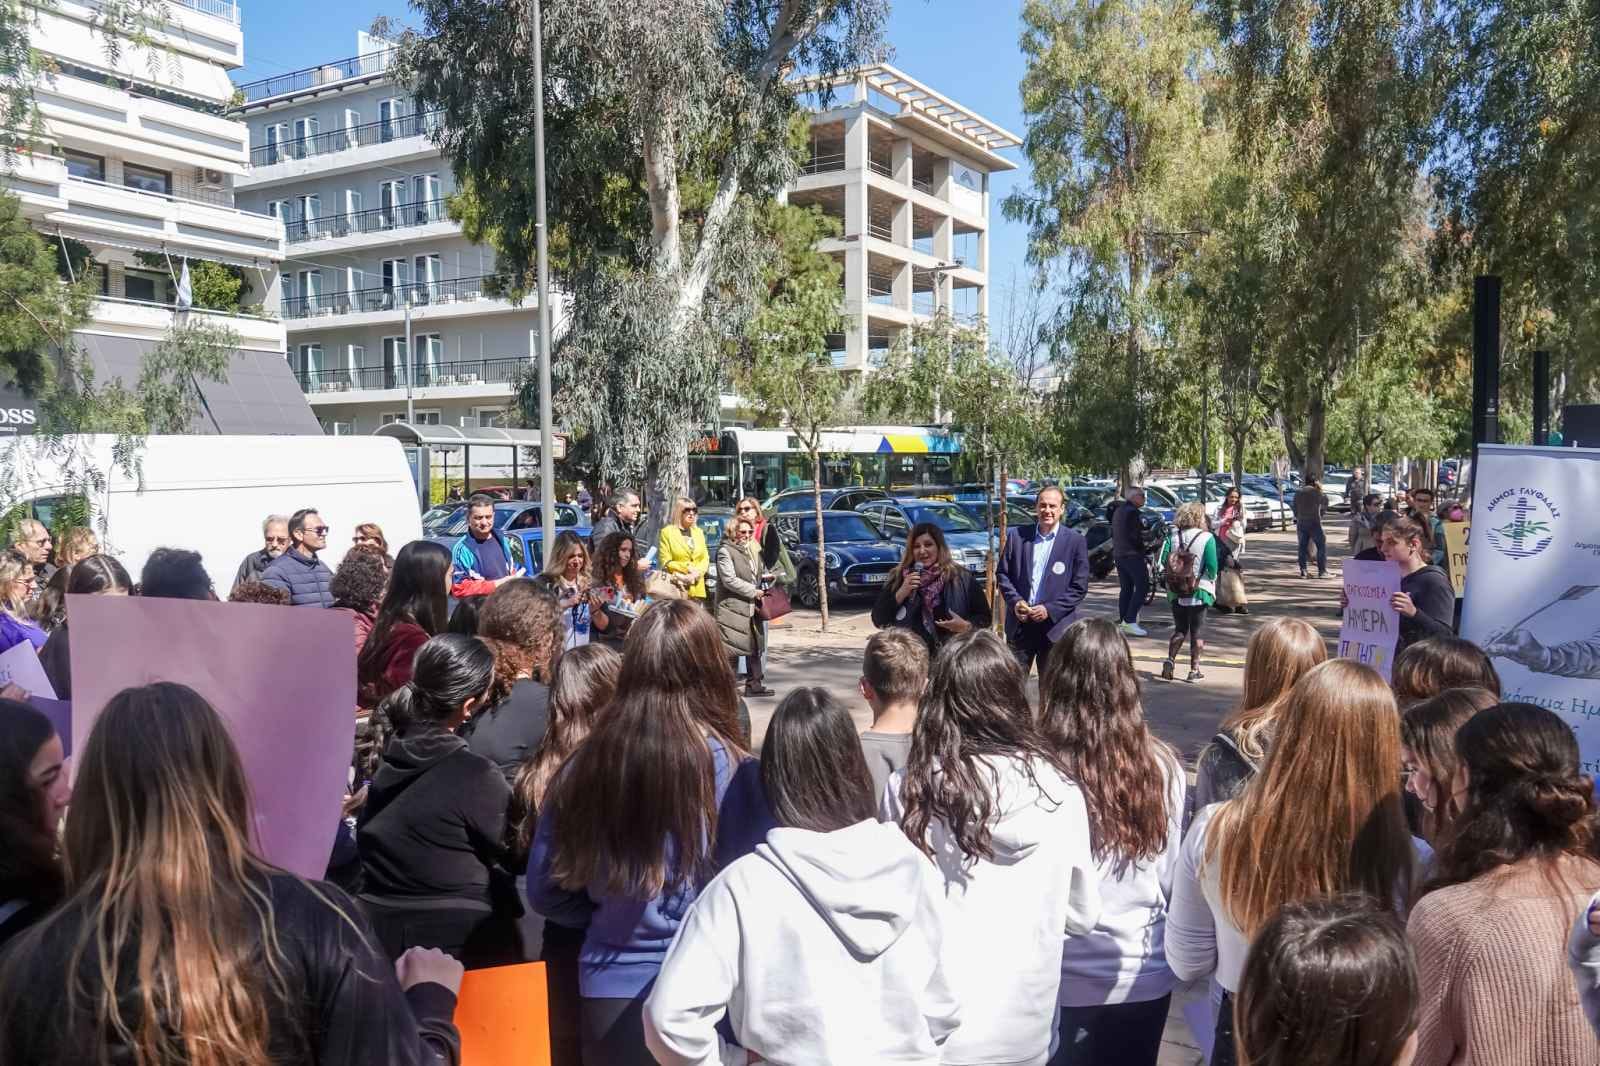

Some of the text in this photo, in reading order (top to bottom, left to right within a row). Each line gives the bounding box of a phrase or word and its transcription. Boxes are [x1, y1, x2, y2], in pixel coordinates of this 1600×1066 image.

[1487, 487, 1561, 520] ΔΗΜΟΣ ΓΛΥΦΑΔΑΣ
[1347, 608, 1389, 633] ΗΜΕΡΑ
